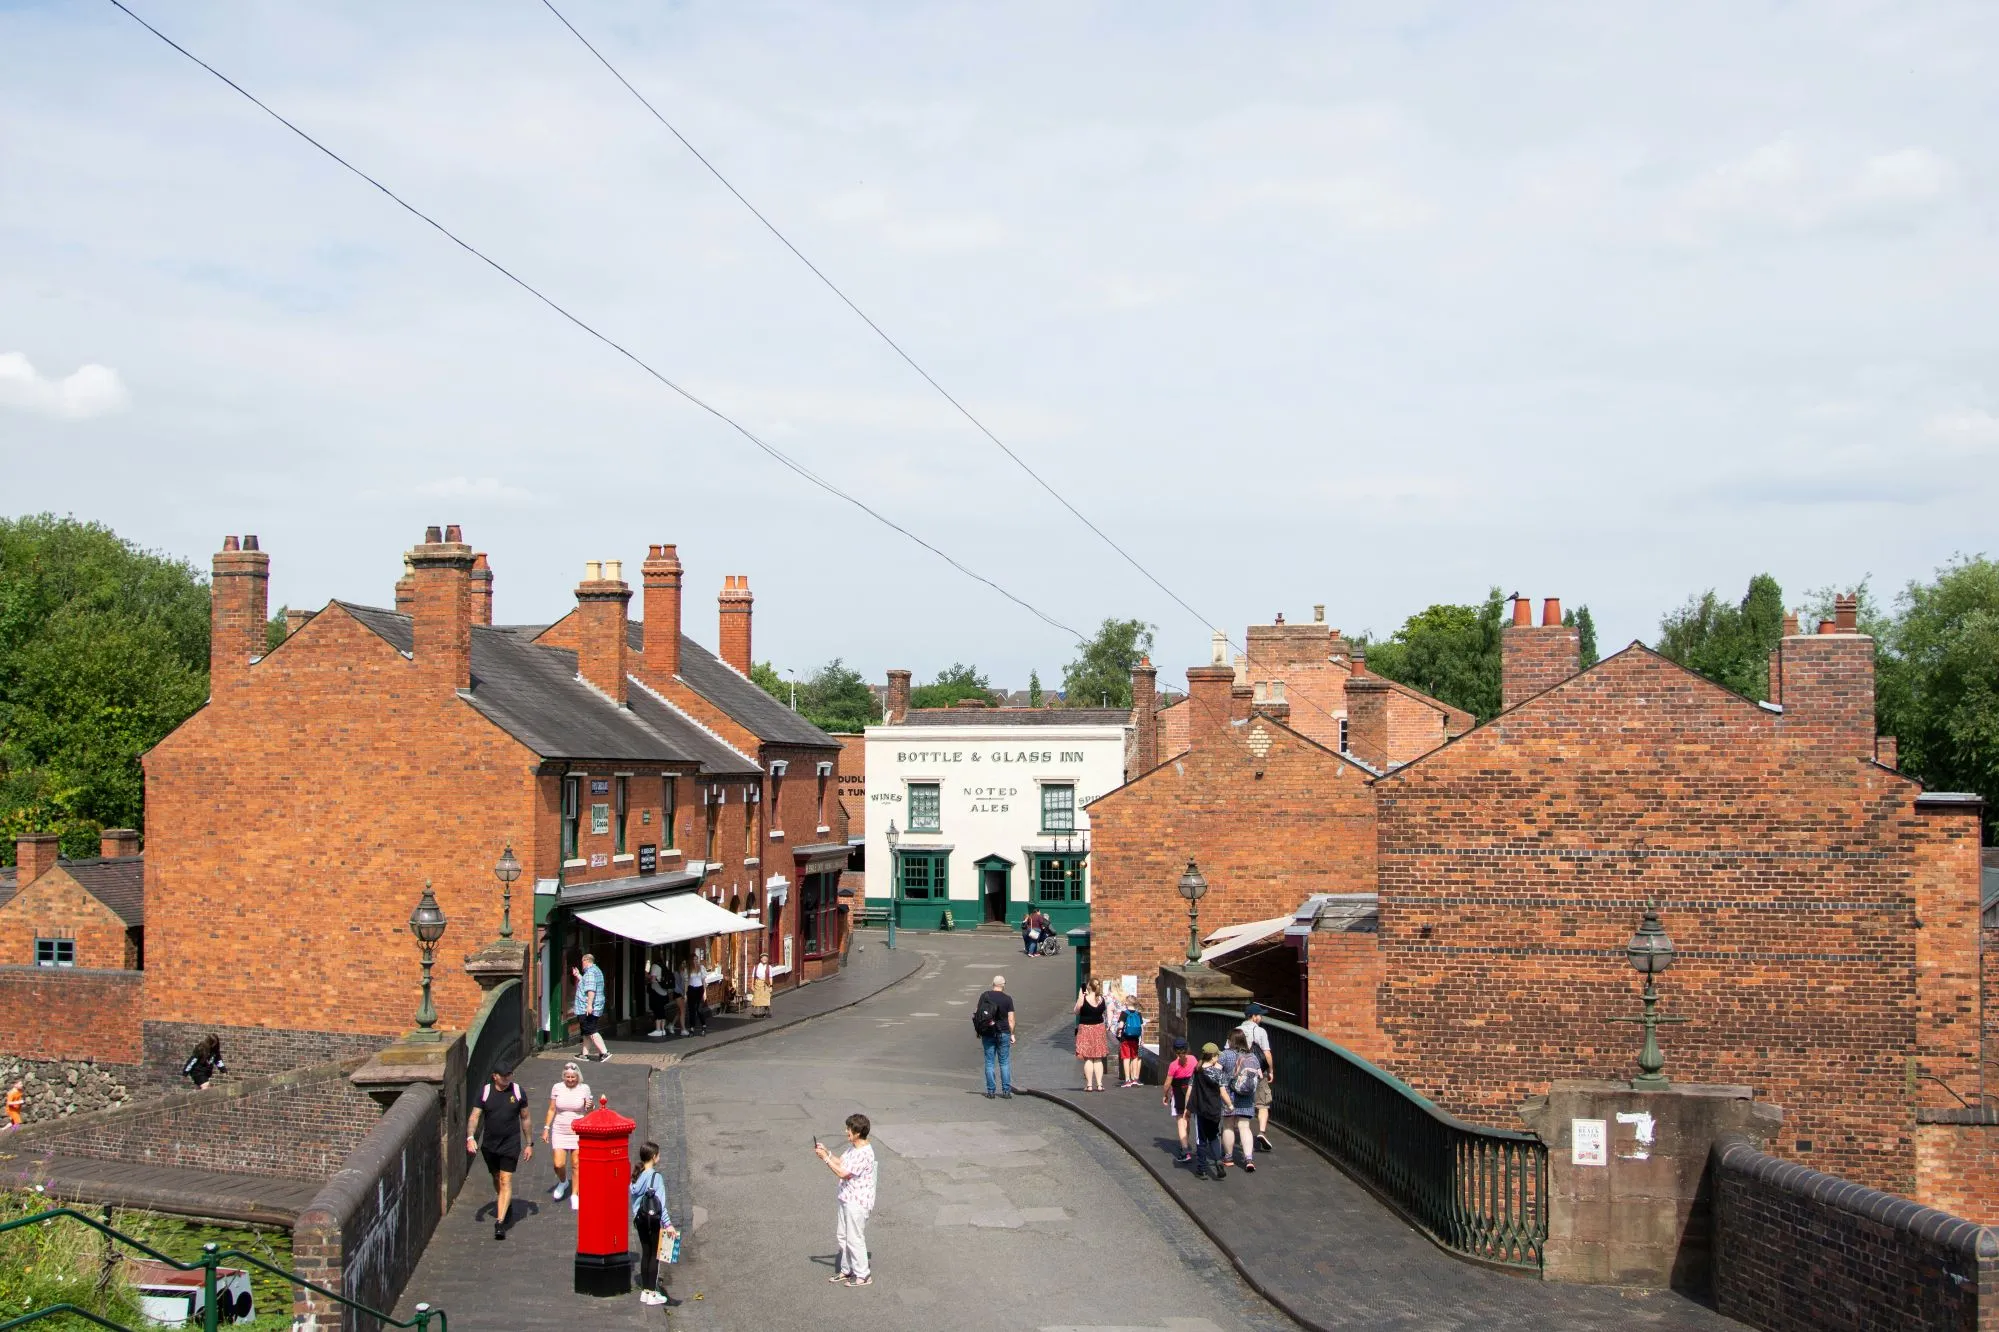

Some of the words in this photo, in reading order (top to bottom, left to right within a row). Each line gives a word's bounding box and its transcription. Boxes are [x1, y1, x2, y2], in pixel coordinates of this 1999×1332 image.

[897, 751, 963, 763] BOTTLE
[970, 751, 982, 763] &
[991, 751, 1052, 763] GLASS
[1060, 751, 1084, 763] INN
[963, 788, 1018, 796] NOTED
[871, 793, 902, 802] WINES
[970, 804, 1009, 813] ALES
